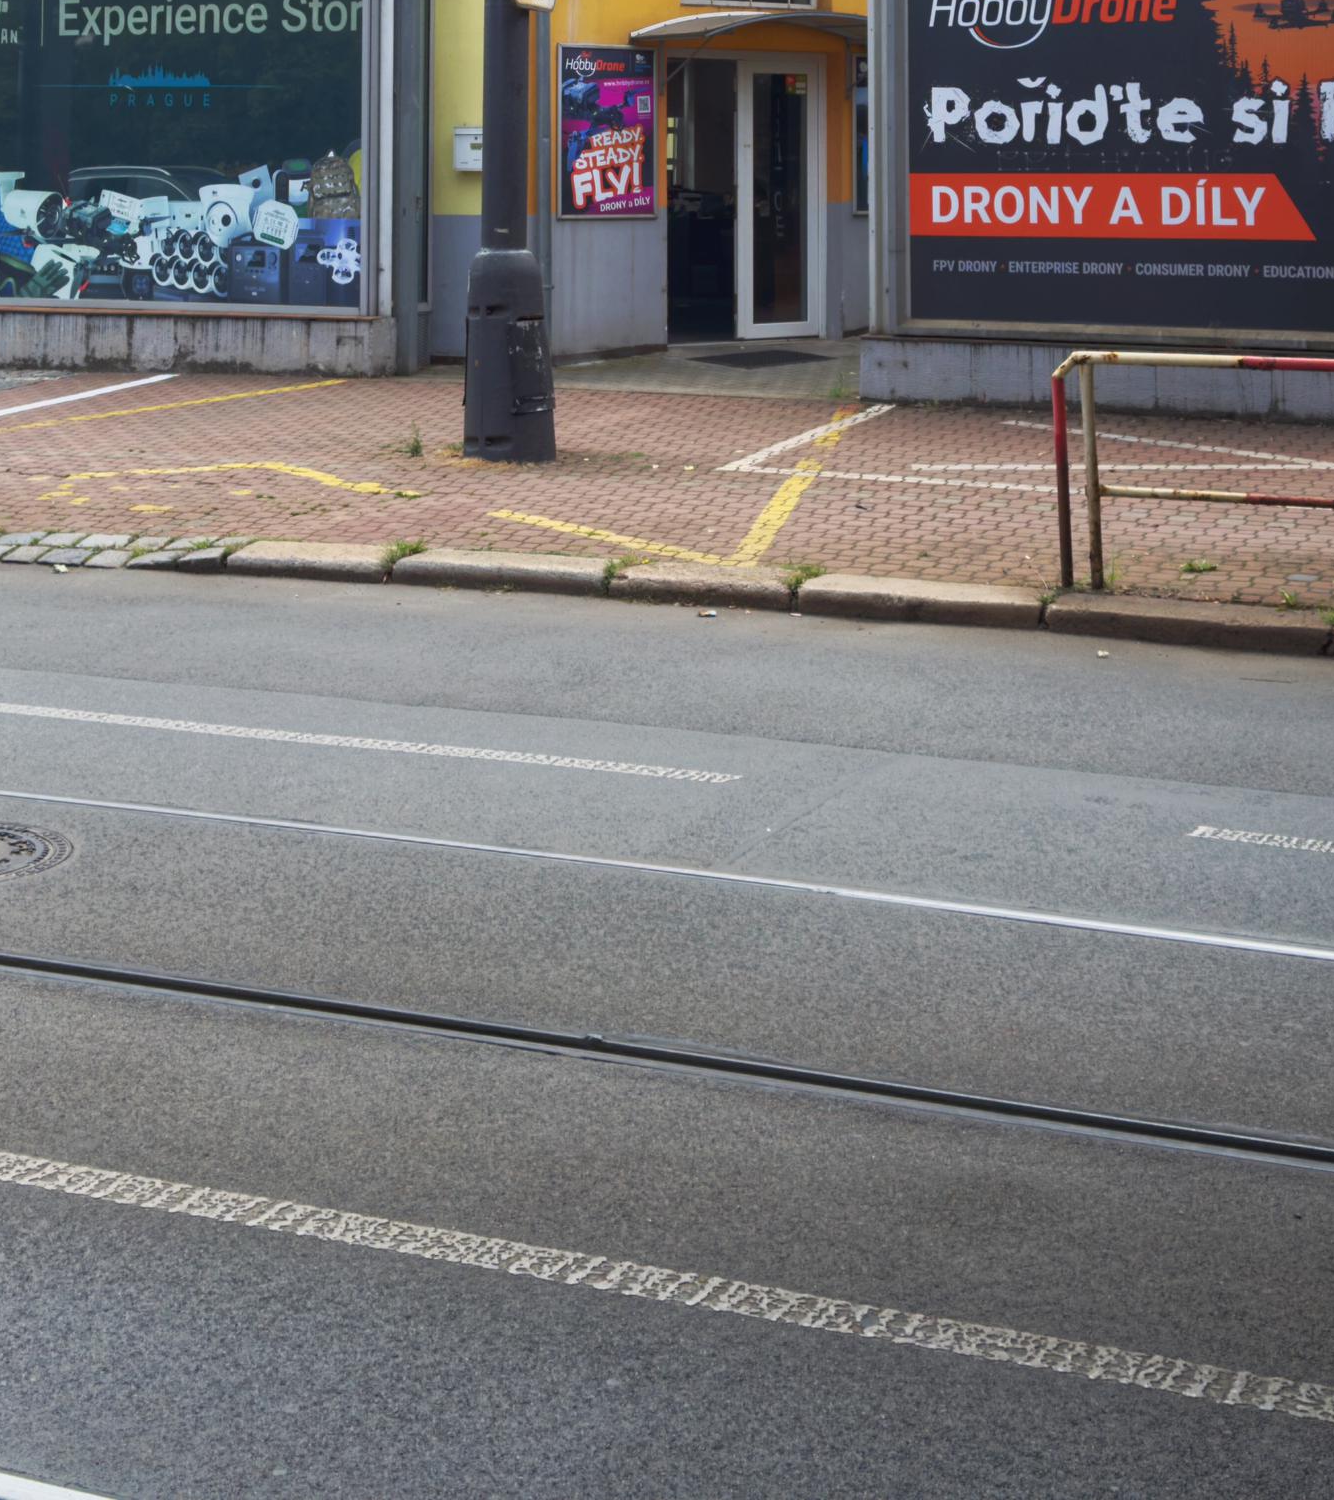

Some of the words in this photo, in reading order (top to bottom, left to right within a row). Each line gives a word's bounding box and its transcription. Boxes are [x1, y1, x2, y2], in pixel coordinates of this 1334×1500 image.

[565, 57, 626, 76] HobbyDrone
[109, 93, 211, 107] PRAGUE
[925, 76, 1205, 145] Pořiďte
[1232, 78, 1292, 145] si
[573, 162, 642, 206] FLY!
[599, 200, 627, 212] DRONY
[634, 196, 651, 206] DÍLY
[931, 185, 1094, 225] DRONY
[1108, 185, 1144, 225] A
[1160, 178, 1267, 227] DÍLY
[932, 259, 955, 272] FPV
[958, 260, 998, 273] DRONY
[1008, 261, 1080, 275] ENTERPRISE
[1082, 262, 1124, 276] DRONY
[1135, 263, 1204, 277] CONSUMER
[1207, 264, 1251, 278] DRONY
[1263, 265, 1334, 279] EDUCATION
